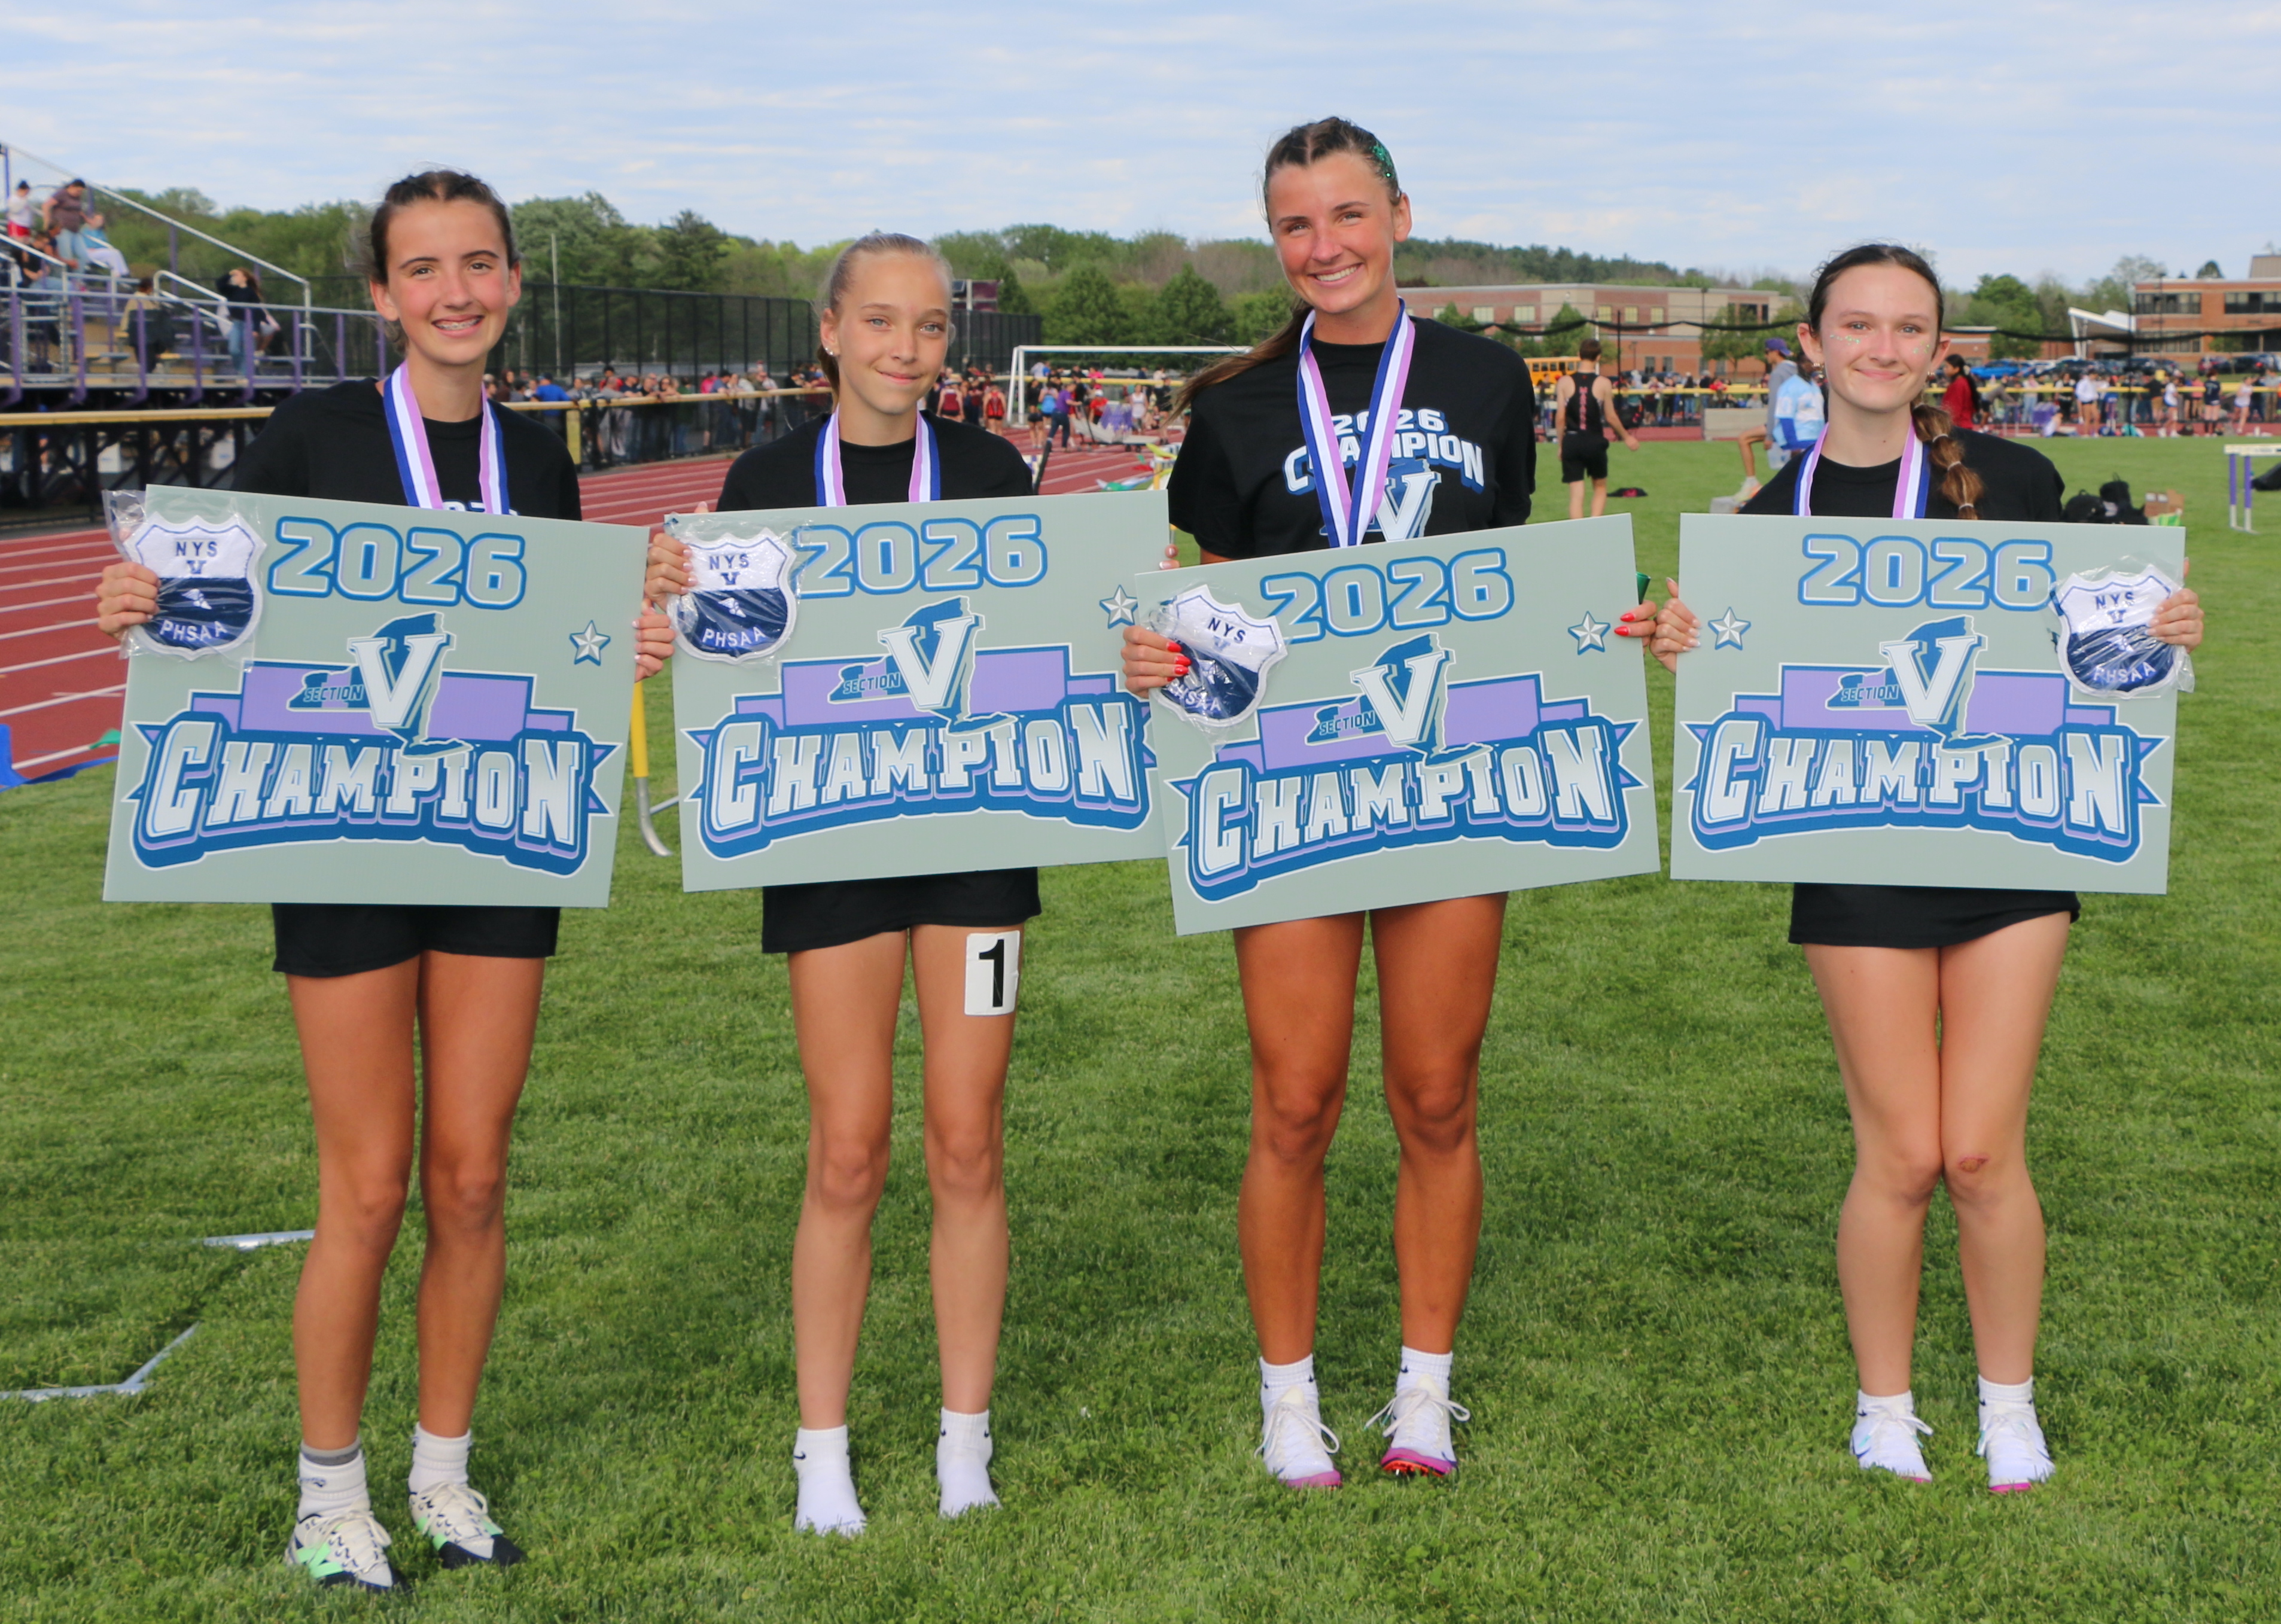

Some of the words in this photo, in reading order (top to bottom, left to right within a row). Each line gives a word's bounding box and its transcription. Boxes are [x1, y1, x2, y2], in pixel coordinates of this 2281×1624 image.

[1284, 431, 1485, 492] CAPION
[175, 541, 218, 557] NYS
[268, 516, 528, 610] 2026
[709, 554, 749, 570] NYS
[792, 514, 1048, 599] 2026
[1798, 534, 2057, 611] 2026
[159, 620, 229, 641] PHSAA
[702, 626, 766, 648] PHSAA
[1207, 617, 1246, 642] NYS
[1260, 547, 1515, 644] 2026
[2096, 591, 2135, 610] NYS
[303, 684, 366, 702] SECTION
[347, 633, 450, 728] V
[843, 671, 900, 694] SECTION
[878, 614, 980, 709] V
[1319, 710, 1376, 736] SECTION
[1350, 650, 1451, 745] V
[1841, 684, 1899, 702] SECTION
[1880, 634, 1982, 724] V
[145, 720, 581, 846] CHAMPION
[711, 700, 1137, 833] CHAMPION
[1198, 724, 1614, 876] CHAMPION
[1701, 717, 2128, 836] CHAMPION
[979, 939, 1004, 1008] 1
